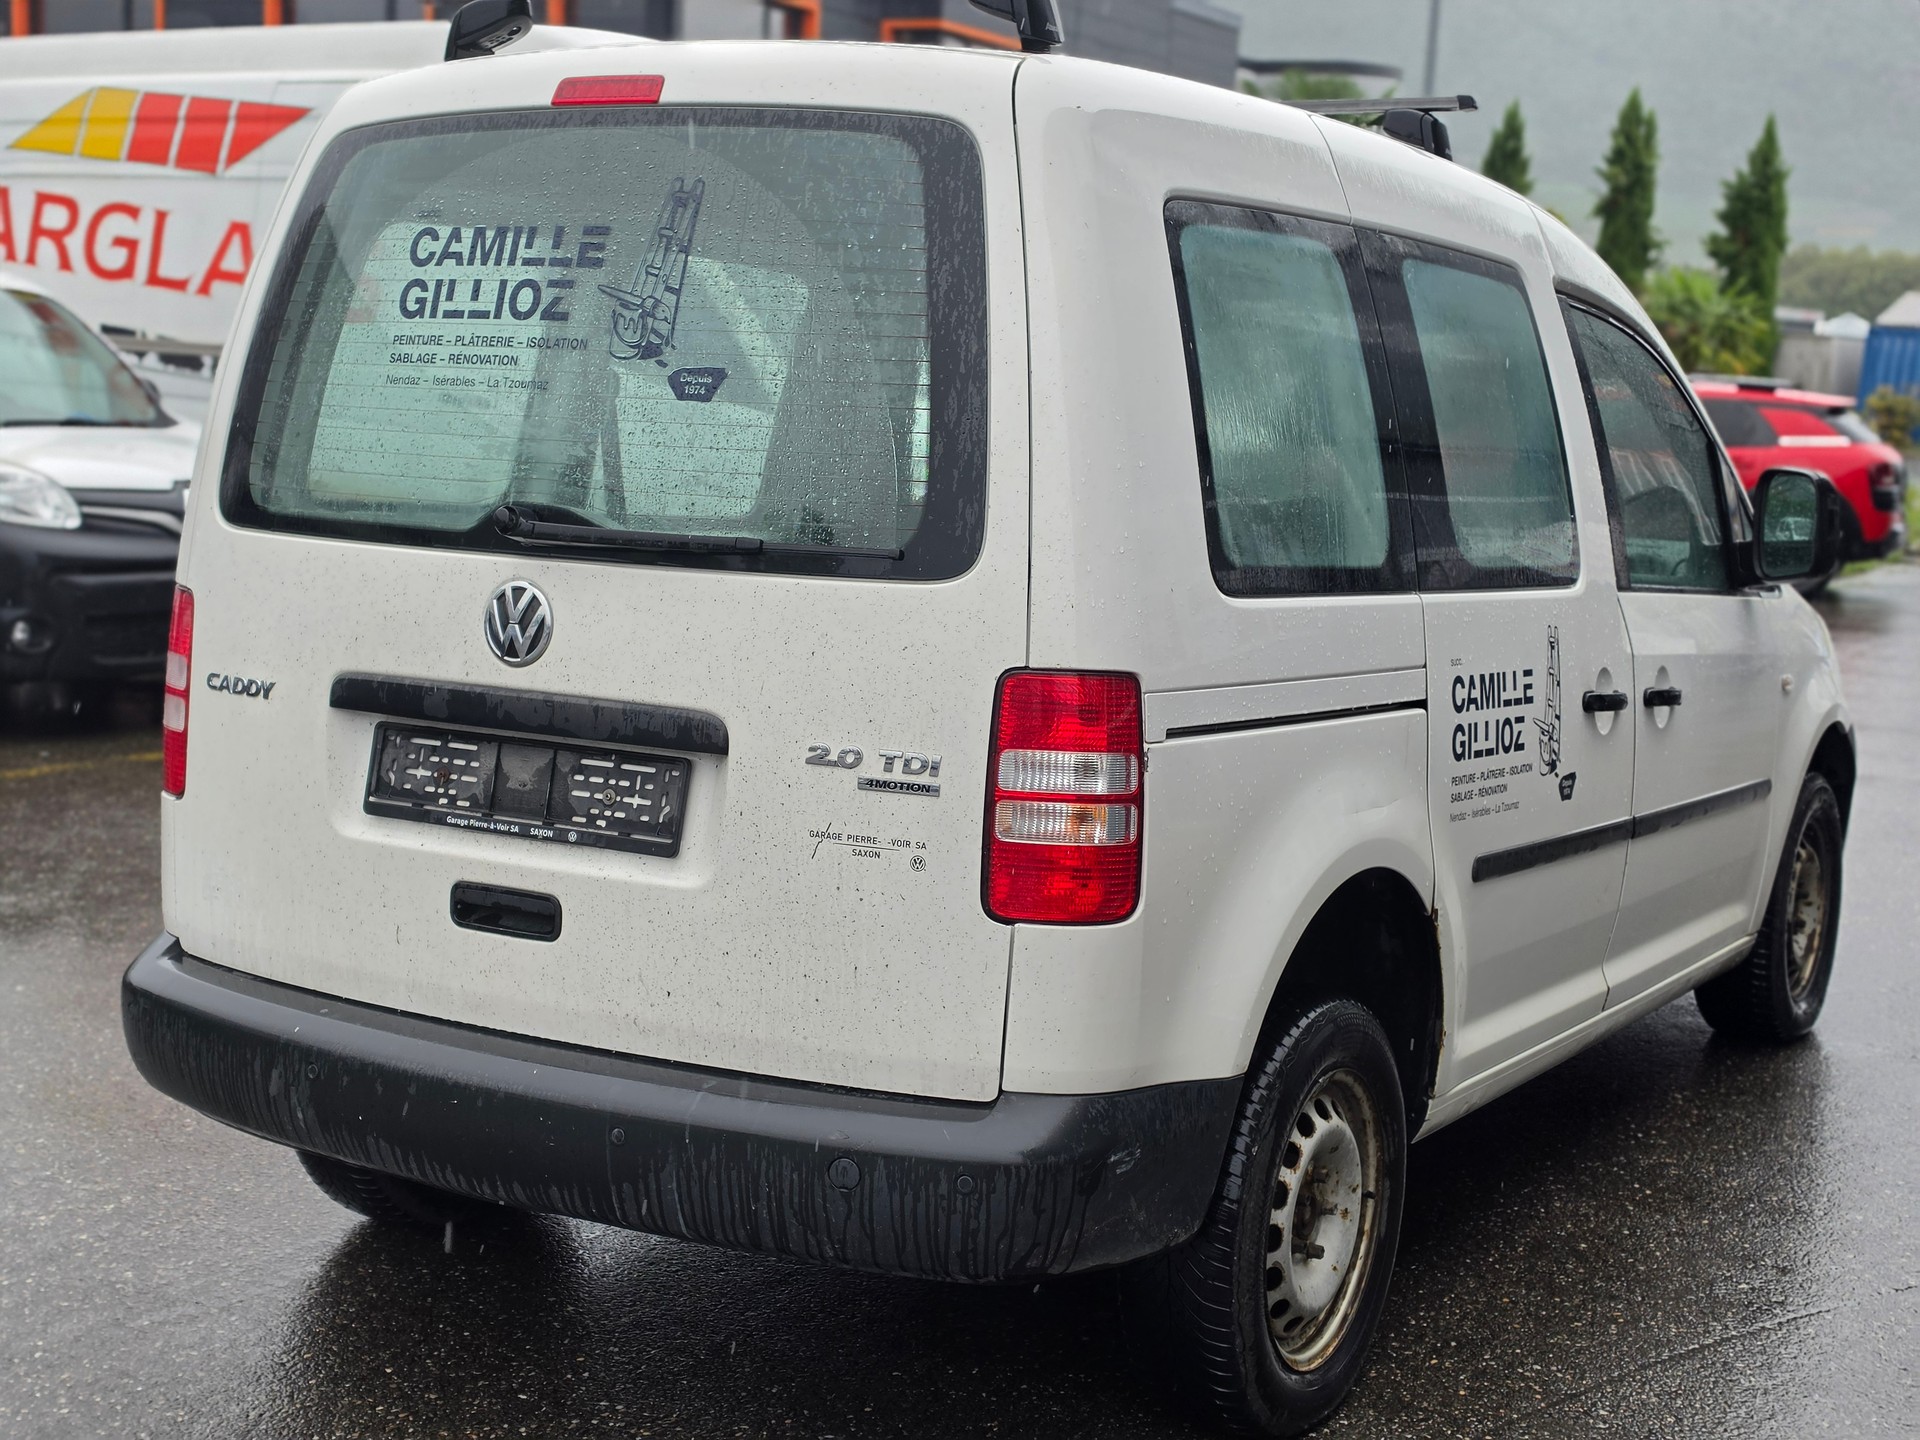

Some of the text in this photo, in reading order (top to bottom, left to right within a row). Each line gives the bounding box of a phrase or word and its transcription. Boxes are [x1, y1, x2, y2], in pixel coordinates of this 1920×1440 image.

[410, 225, 612, 268] CAMILLE
[399, 278, 575, 322] GILLIOZ
[392, 334, 444, 346] PEINTURE
[454, 333, 515, 348] PLÂTRERIE
[526, 337, 588, 350] ISOLATION
[389, 352, 437, 364] SABLAGE
[448, 351, 519, 366] RÉNOVATION
[385, 374, 421, 386] Nendaz
[432, 374, 476, 387] Isérables
[487, 377, 500, 388] La
[503, 378, 549, 391] Tzoumaz
[680, 373, 713, 384] Depuis
[684, 385, 706, 395] 1974
[206, 672, 277, 700] CADDY
[1452, 669, 1534, 714] CAMILLE
[1452, 716, 1526, 762] GILLIOZ
[805, 742, 942, 778] 2.0 TDI
[1451, 773, 1476, 787] PEINTURE
[1509, 763, 1533, 776] ISOLATION
[865, 778, 931, 794] 4MOTION
[1450, 790, 1474, 804] SABLAGE
[446, 815, 554, 838] Garage Pierre-à-Voir SA SAXON
[809, 830, 843, 841] GARAGE
[915, 841, 927, 850] SA
[851, 849, 881, 859] SAXON
